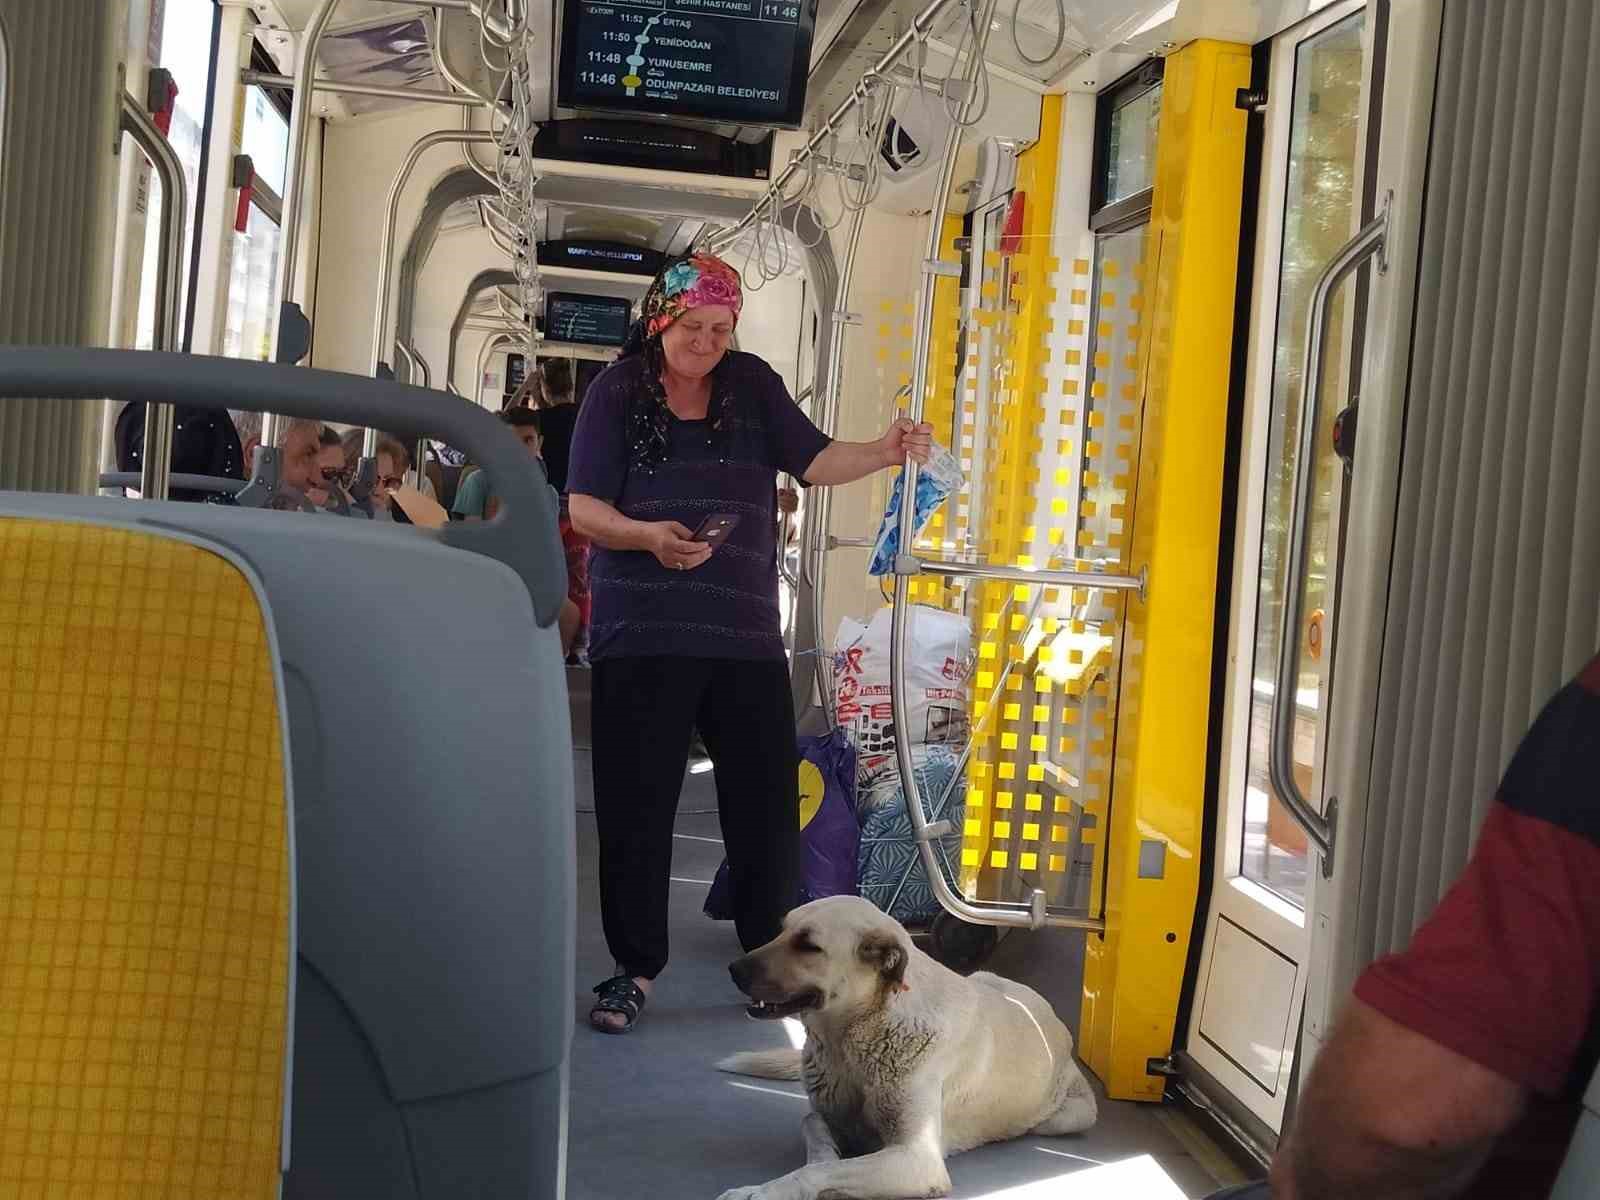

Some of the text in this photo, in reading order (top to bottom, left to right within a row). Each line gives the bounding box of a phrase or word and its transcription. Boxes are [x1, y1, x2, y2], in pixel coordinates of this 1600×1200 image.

[603, 31, 630, 42] 11:50
[587, 51, 621, 63] 11:48
[647, 58, 713, 72] YUNUSEMRE
[580, 71, 616, 85] 11:46
[645, 78, 715, 95] ODUNPAZARI
[716, 86, 780, 101] BELEDİYESİ
